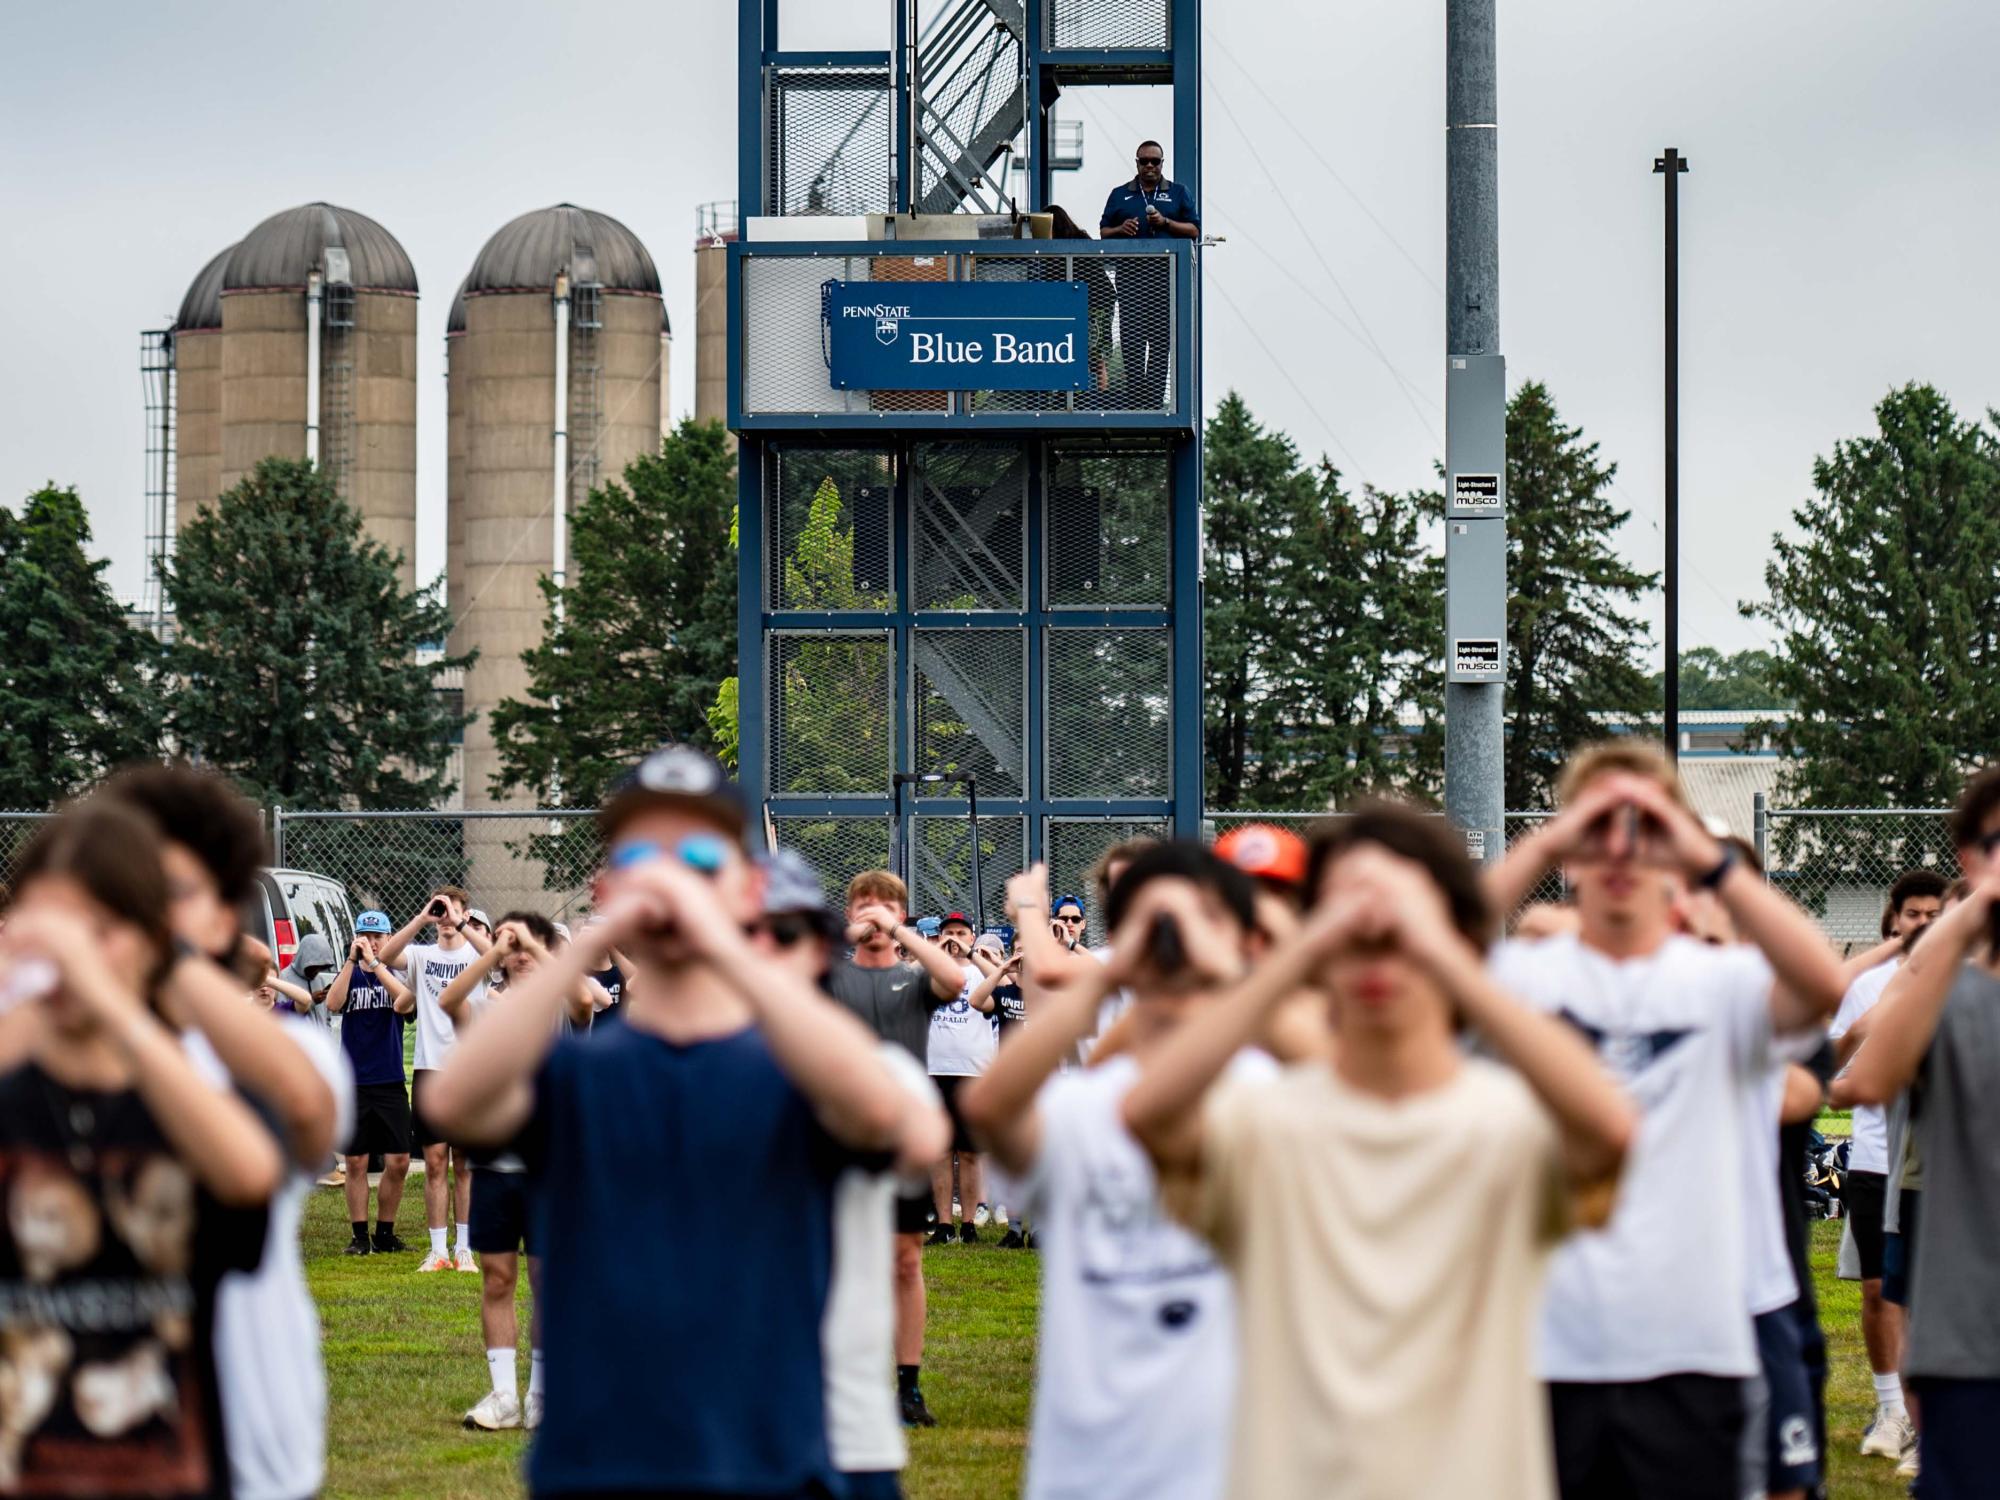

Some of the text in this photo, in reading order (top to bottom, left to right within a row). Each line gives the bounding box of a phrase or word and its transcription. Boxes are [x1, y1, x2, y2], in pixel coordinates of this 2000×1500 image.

[909, 332, 1076, 363] Blue Band
[372, 986, 393, 1009] STA
